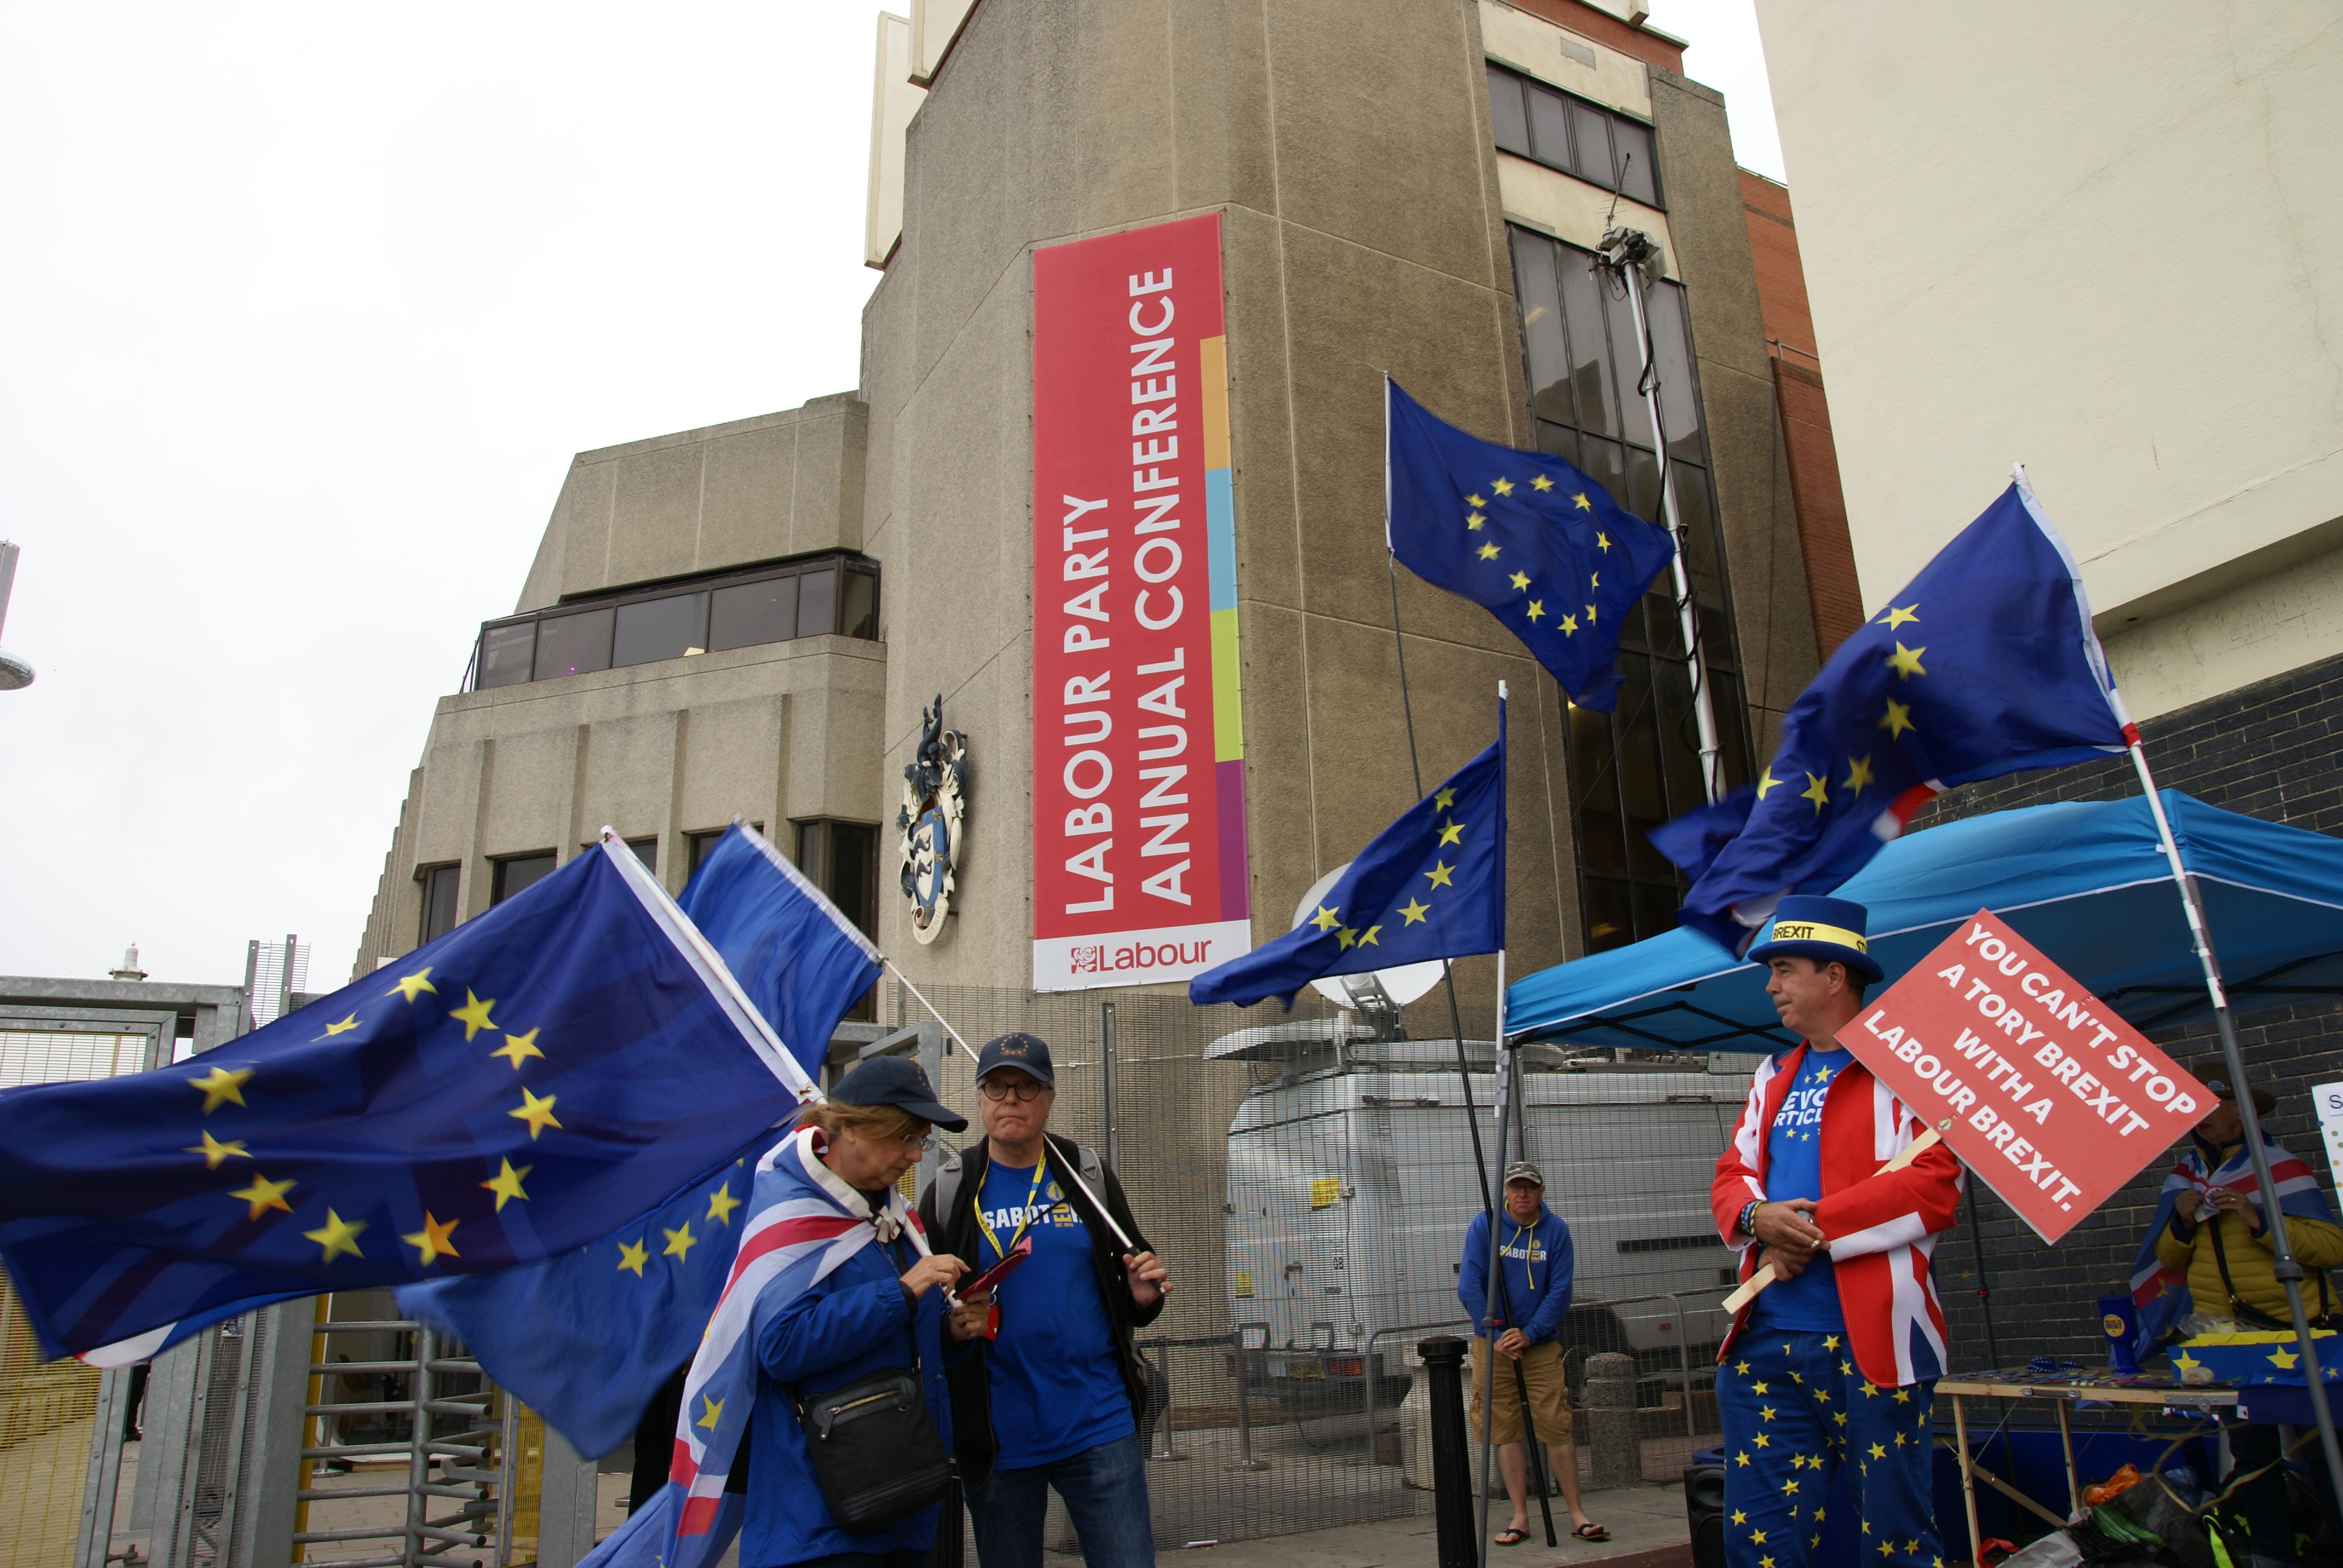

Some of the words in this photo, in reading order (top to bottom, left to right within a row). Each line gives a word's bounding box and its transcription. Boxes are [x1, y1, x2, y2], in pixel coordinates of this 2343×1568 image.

[1129, 267, 1184, 630] CONFERENCE
[1063, 494, 1110, 654] PARTY
[1063, 670, 1114, 915] LABOUR
[1137, 646, 1191, 906] ANNUAL
[1099, 939, 1212, 972] Labour
[1773, 926, 1814, 939] BREXIT
[1781, 1086, 1829, 1111] EVO
[1937, 963, 1967, 989] A
[1964, 976, 2045, 1046] TORY
[2033, 1040, 2149, 1137] BREXIT
[1953, 1027, 2037, 1103] WITH
[2024, 1097, 2054, 1125] A
[1965, 921, 2028, 976] YOU
[2021, 972, 2117, 1048] CAN'T
[2107, 1045, 2197, 1119] STOP
[1773, 1108, 1822, 1127] RTICL
[1864, 1009, 1977, 1115] LABOUR
[1968, 1105, 2082, 1212] BREXIT.
